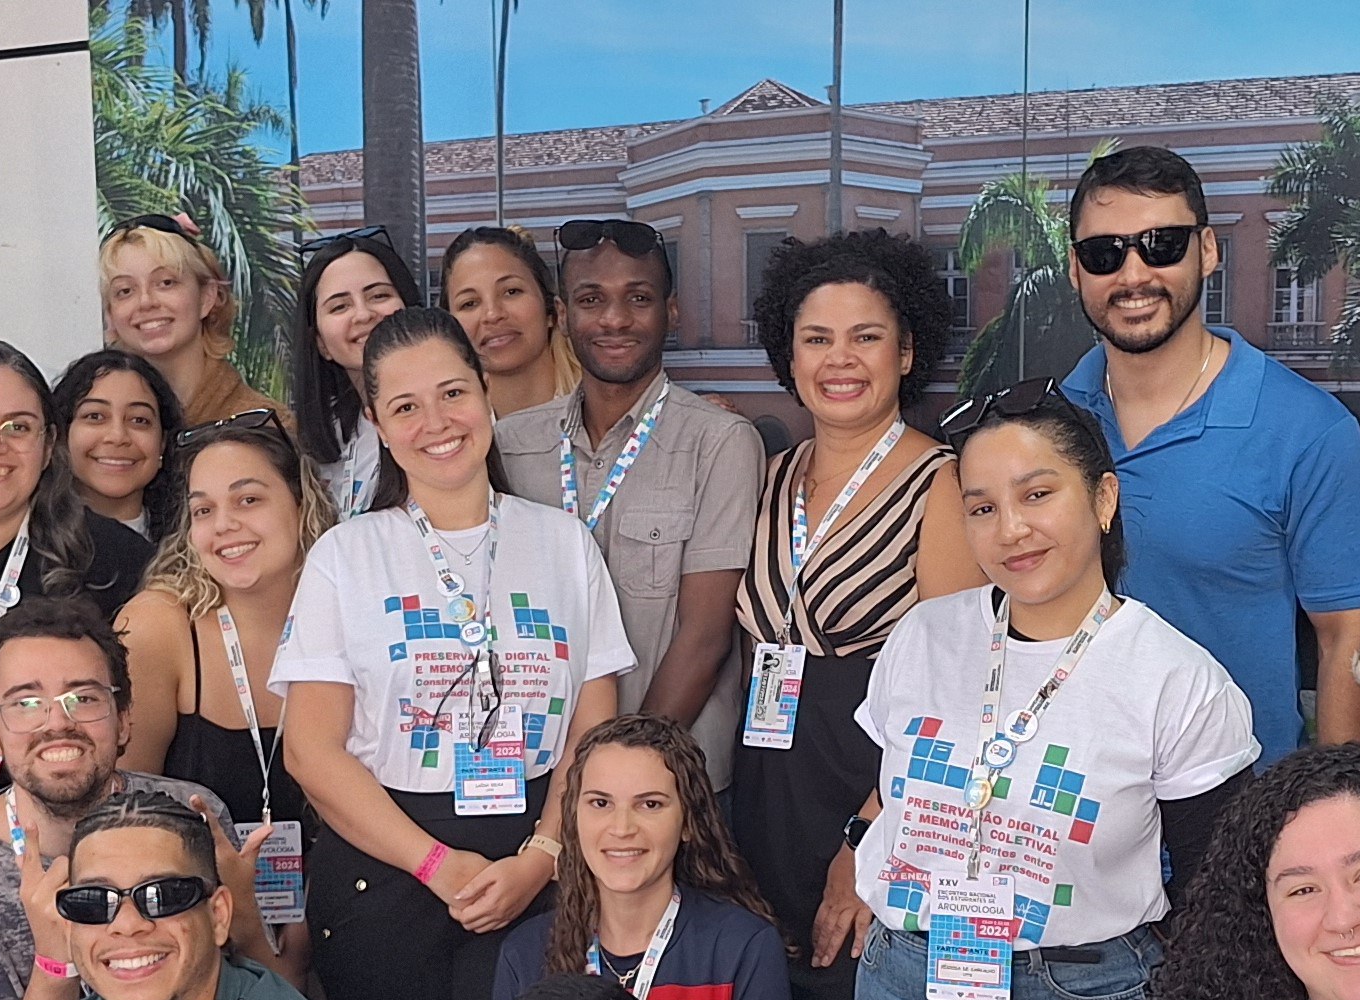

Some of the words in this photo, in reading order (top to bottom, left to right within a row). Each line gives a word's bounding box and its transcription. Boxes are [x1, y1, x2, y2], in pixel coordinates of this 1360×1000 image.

[415, 651, 499, 662] PRESERVA
[505, 651, 551, 662] DIGITAL
[416, 665, 424, 675] E
[497, 664, 552, 675] OLETIVA:
[495, 747, 521, 757] 2024
[906, 796, 1003, 827] PRESERVAÃO
[1007, 818, 1061, 842] DIGITAL
[904, 811, 912, 822] E
[919, 811, 974, 834] MEMÓR
[990, 829, 1058, 856] COLETIVA:
[902, 826, 974, 849] Construindo
[980, 843, 1017, 859] pontes
[1023, 853, 1054, 871] entre
[275, 860, 300, 871] 2024
[916, 844, 965, 861] passado
[998, 861, 1051, 885] presente
[938, 878, 959, 887] XXV
[937, 902, 1006, 915] ARQUIVOLOGIA
[979, 925, 1010, 937] 2024
